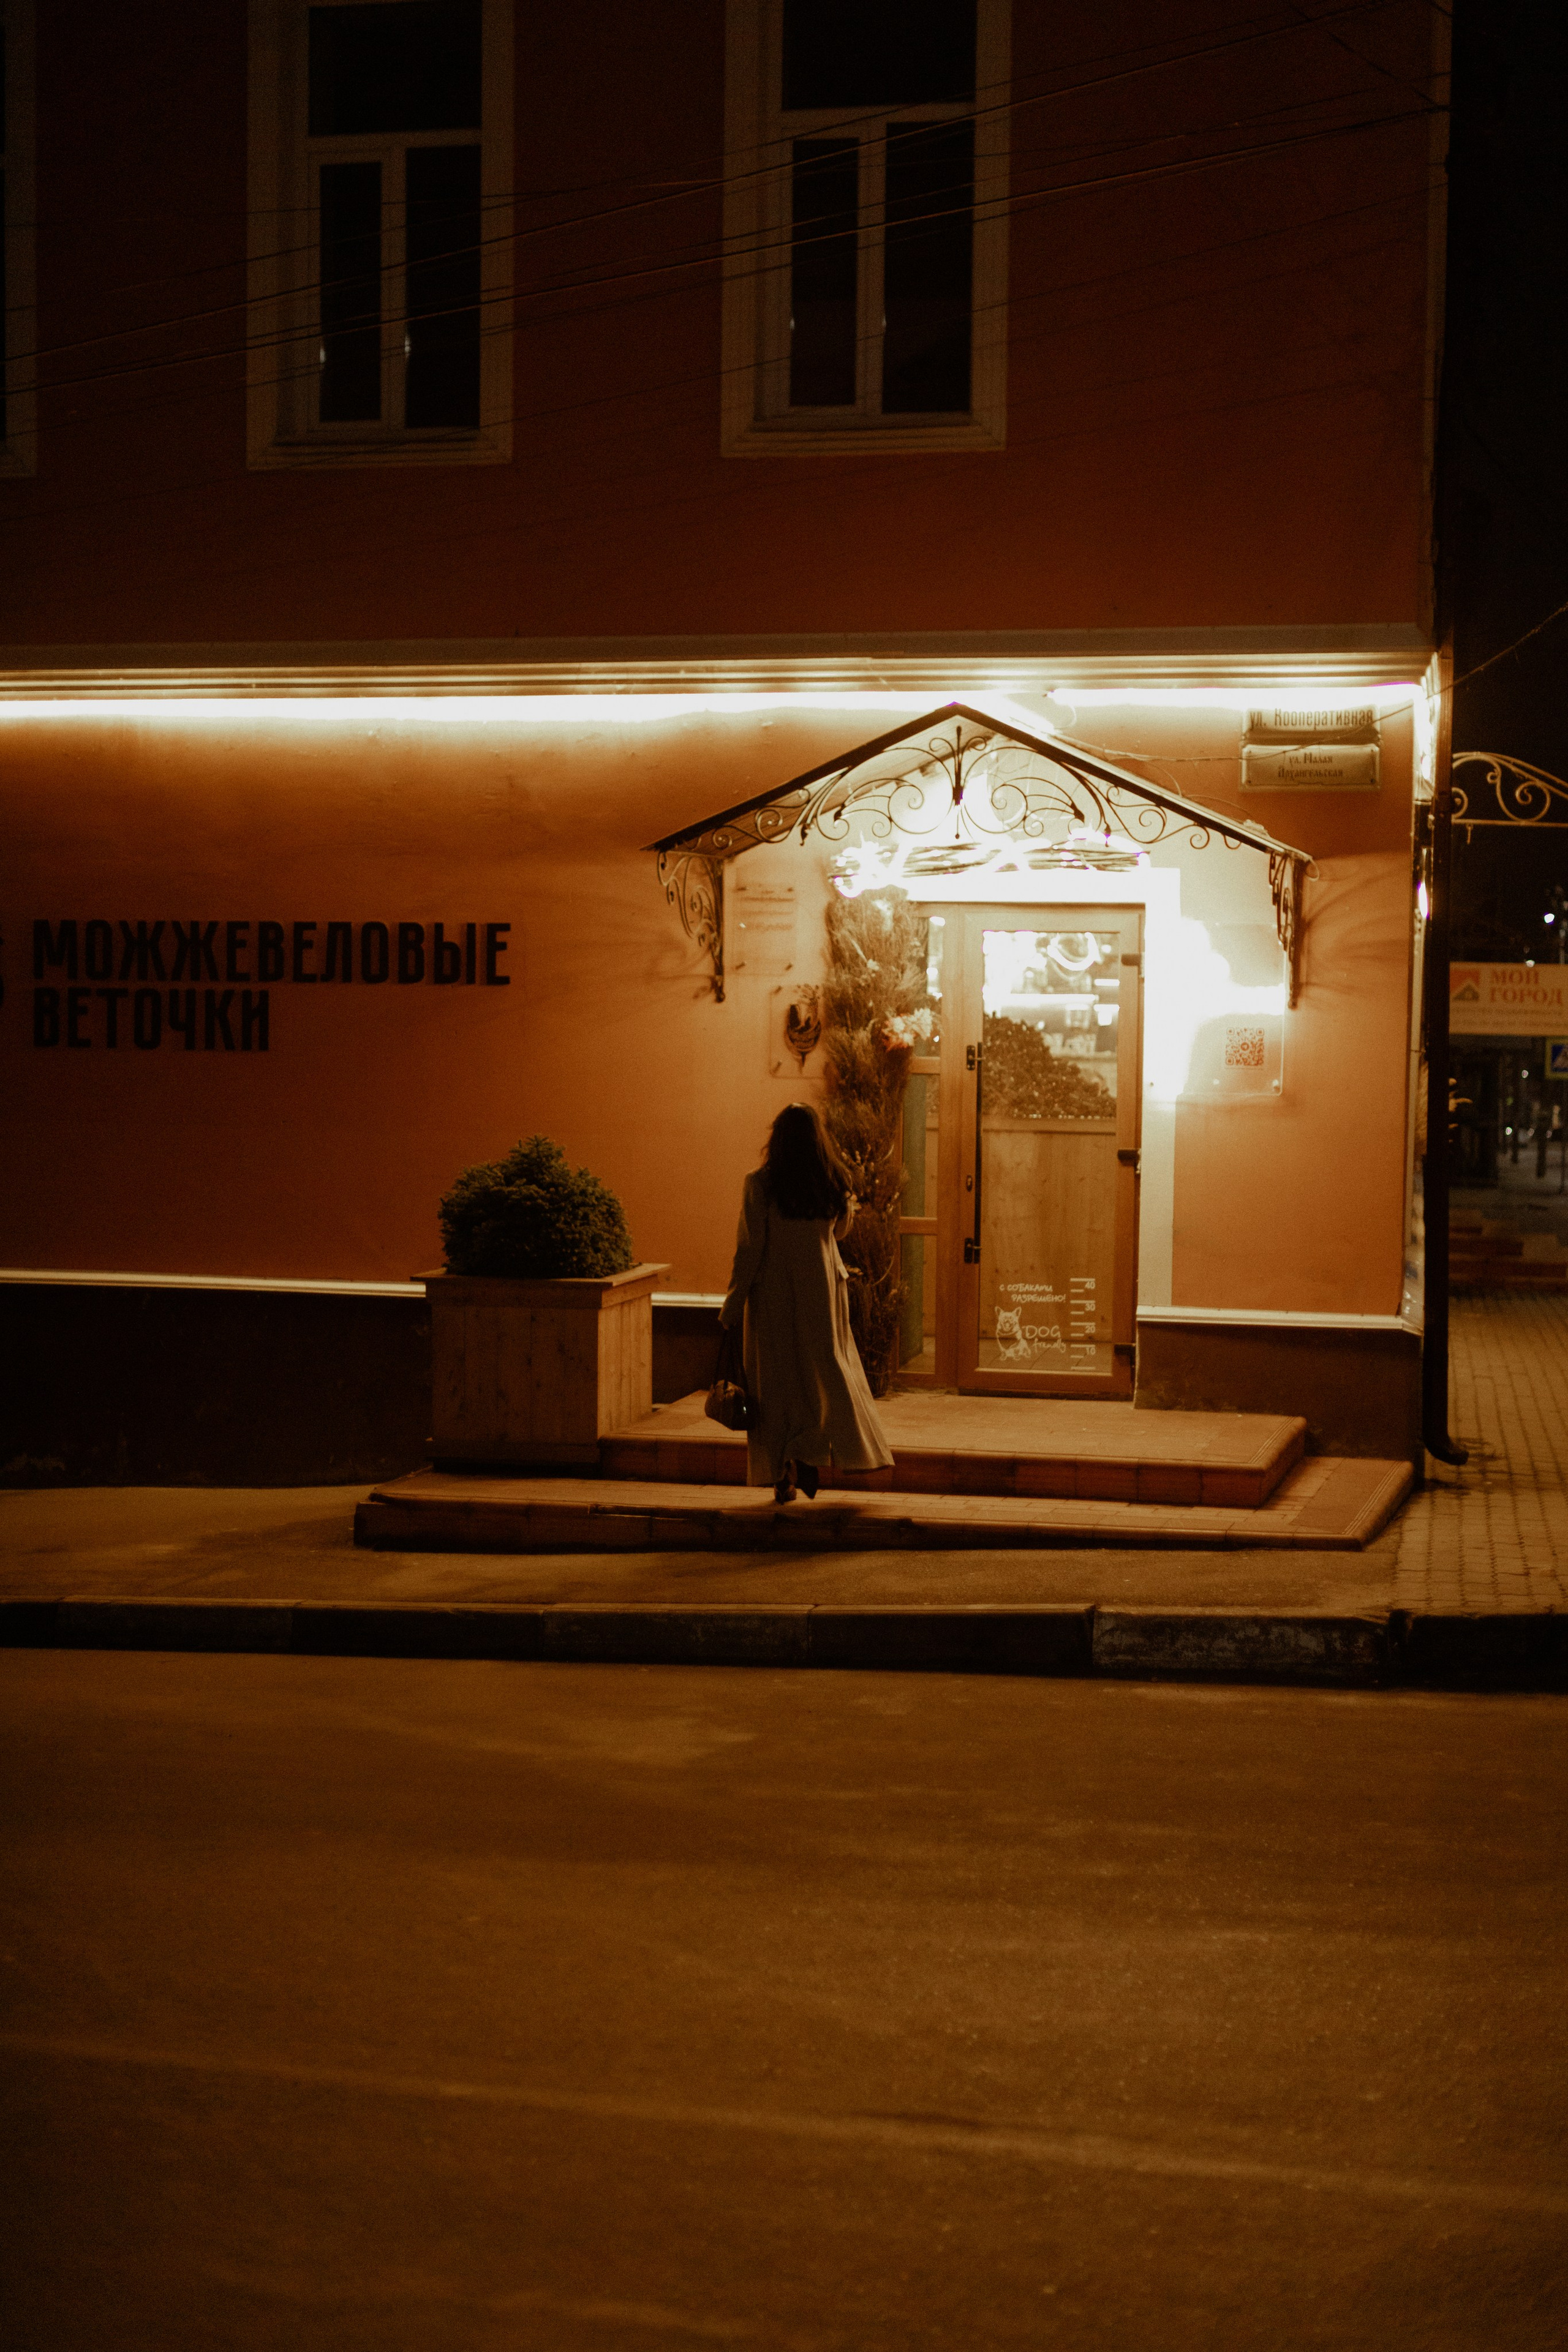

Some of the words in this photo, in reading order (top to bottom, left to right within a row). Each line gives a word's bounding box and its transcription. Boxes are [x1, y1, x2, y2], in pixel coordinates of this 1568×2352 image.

[1250, 711, 1266, 729] ул.
[1275, 708, 1373, 729] Кооперативная
[33, 919, 511, 986] МОЖЖЕВЕЛОВЫЕ
[1490, 987, 1562, 1006] ГОРОД
[33, 987, 270, 1051] ВЕТОЧКИ
[1085, 1281, 1096, 1289] 40
[1085, 1303, 1096, 1311] 30
[1022, 1325, 1061, 1339] DOG
[1085, 1325, 1096, 1333] 20
[1085, 1347, 1096, 1355] 10
